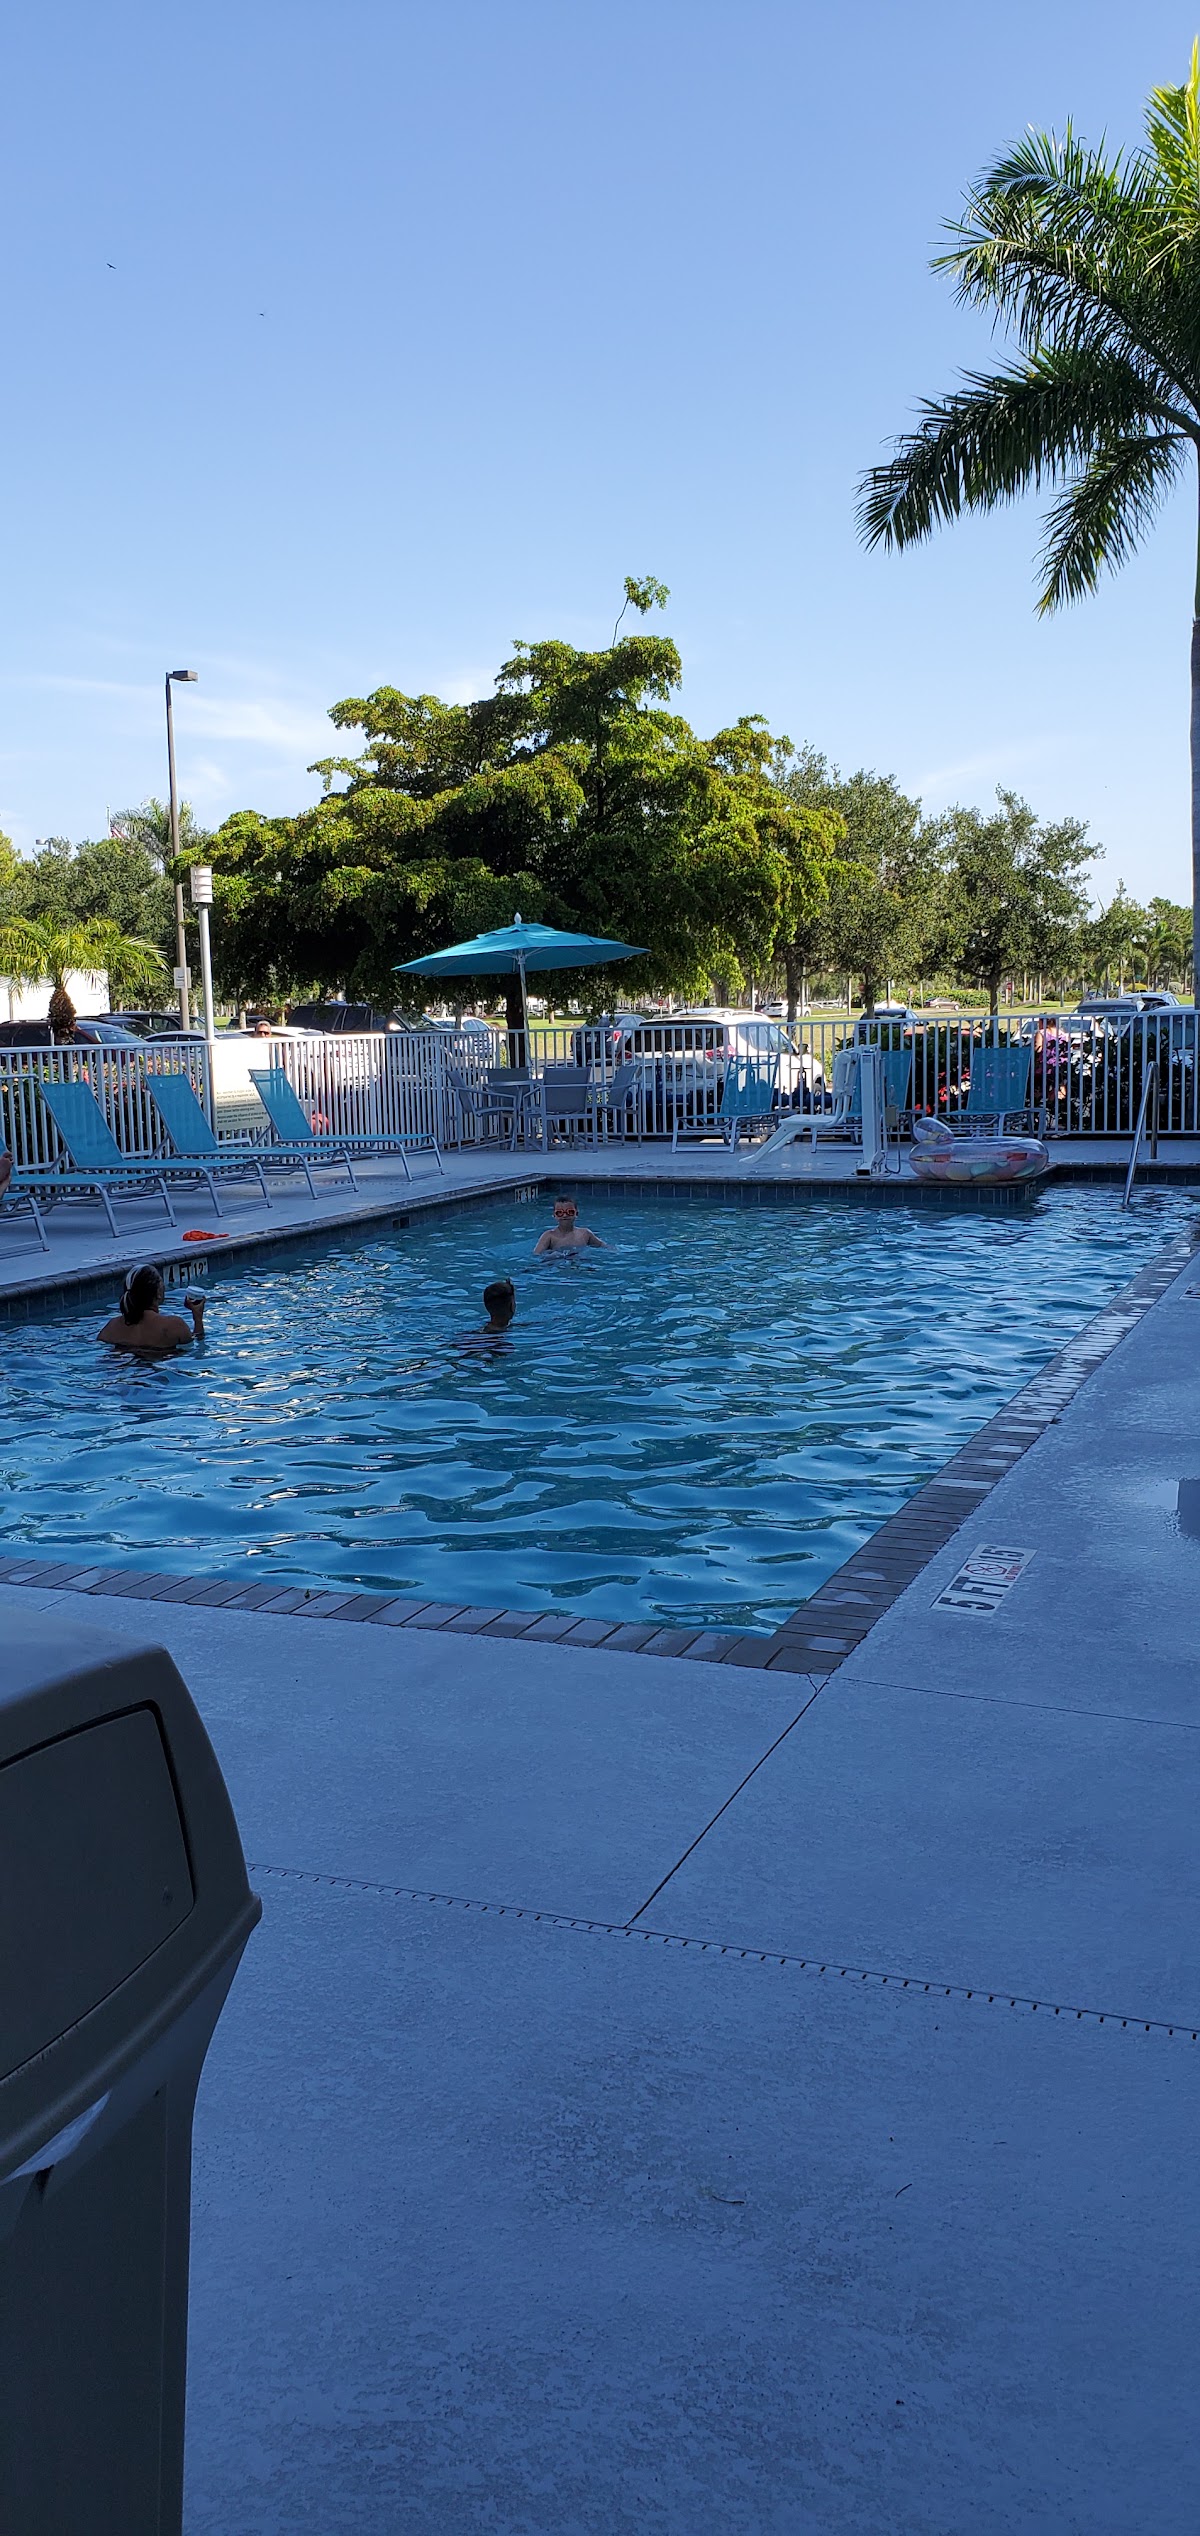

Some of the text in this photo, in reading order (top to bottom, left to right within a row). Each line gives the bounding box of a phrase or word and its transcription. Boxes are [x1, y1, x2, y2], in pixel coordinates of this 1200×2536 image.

[179, 1261, 192, 1283] FT
[949, 1575, 1010, 1598] FT
[937, 1596, 996, 1611] 5
